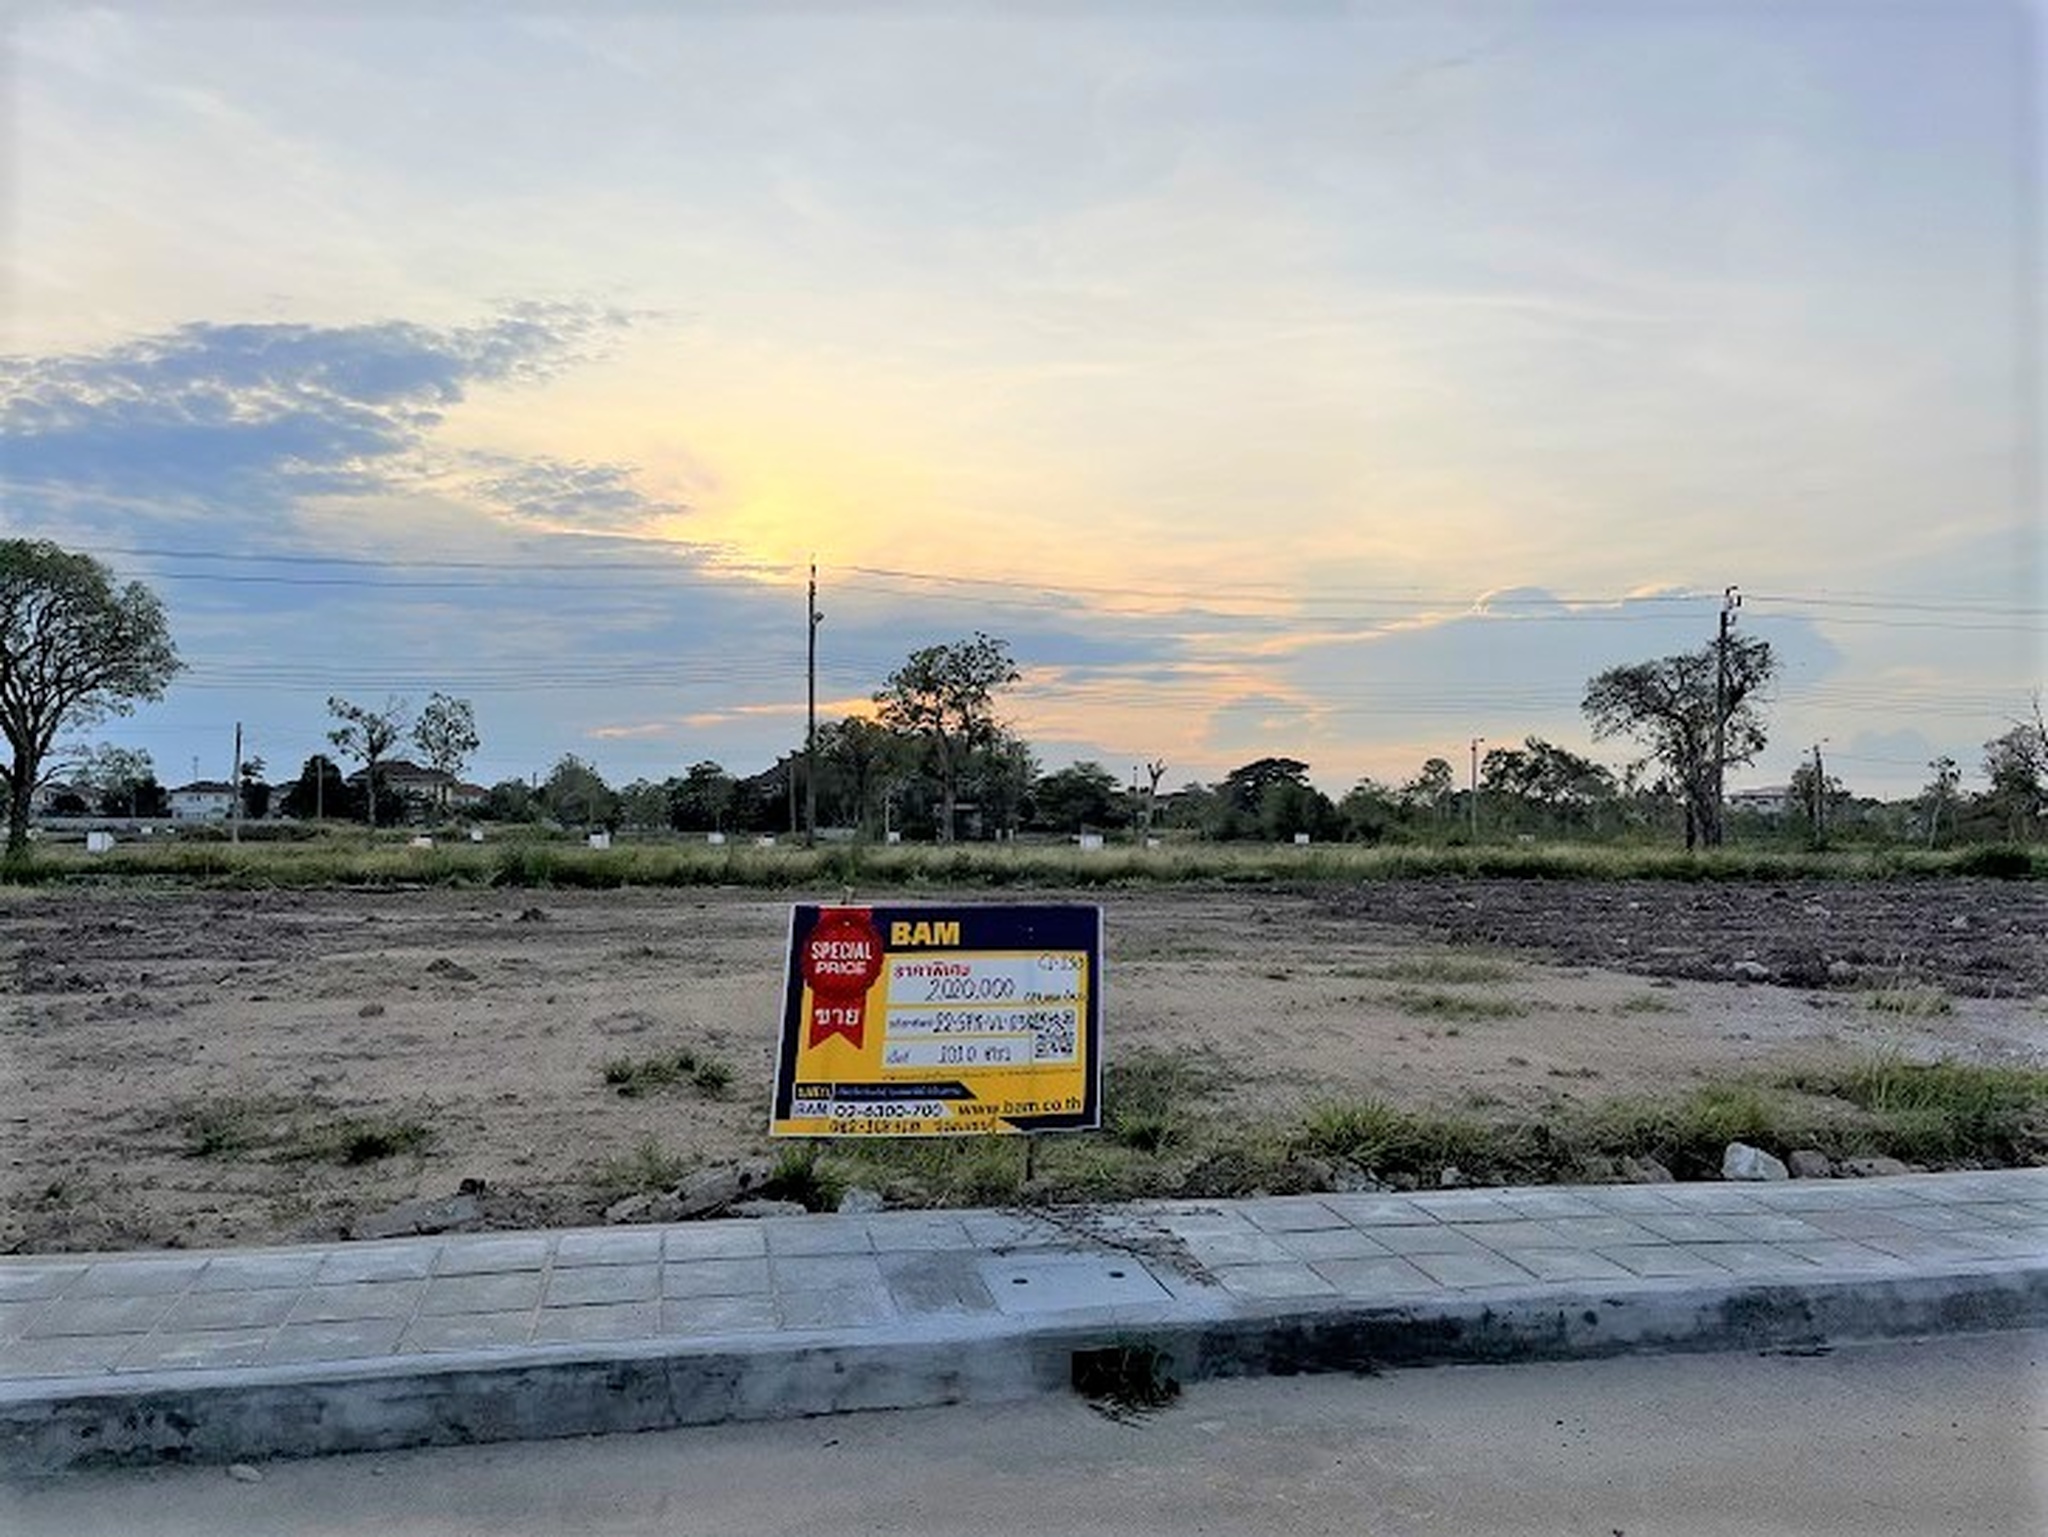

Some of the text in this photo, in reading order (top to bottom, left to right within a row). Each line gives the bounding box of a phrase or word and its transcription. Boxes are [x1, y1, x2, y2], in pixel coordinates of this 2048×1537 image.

[891, 921, 960, 946] BAM
[811, 941, 873, 960] SPECIAL
[814, 961, 867, 974] PRICE
[814, 1008, 860, 1026] ขาย
[958, 1096, 1081, 1115] www.bam.co.th
